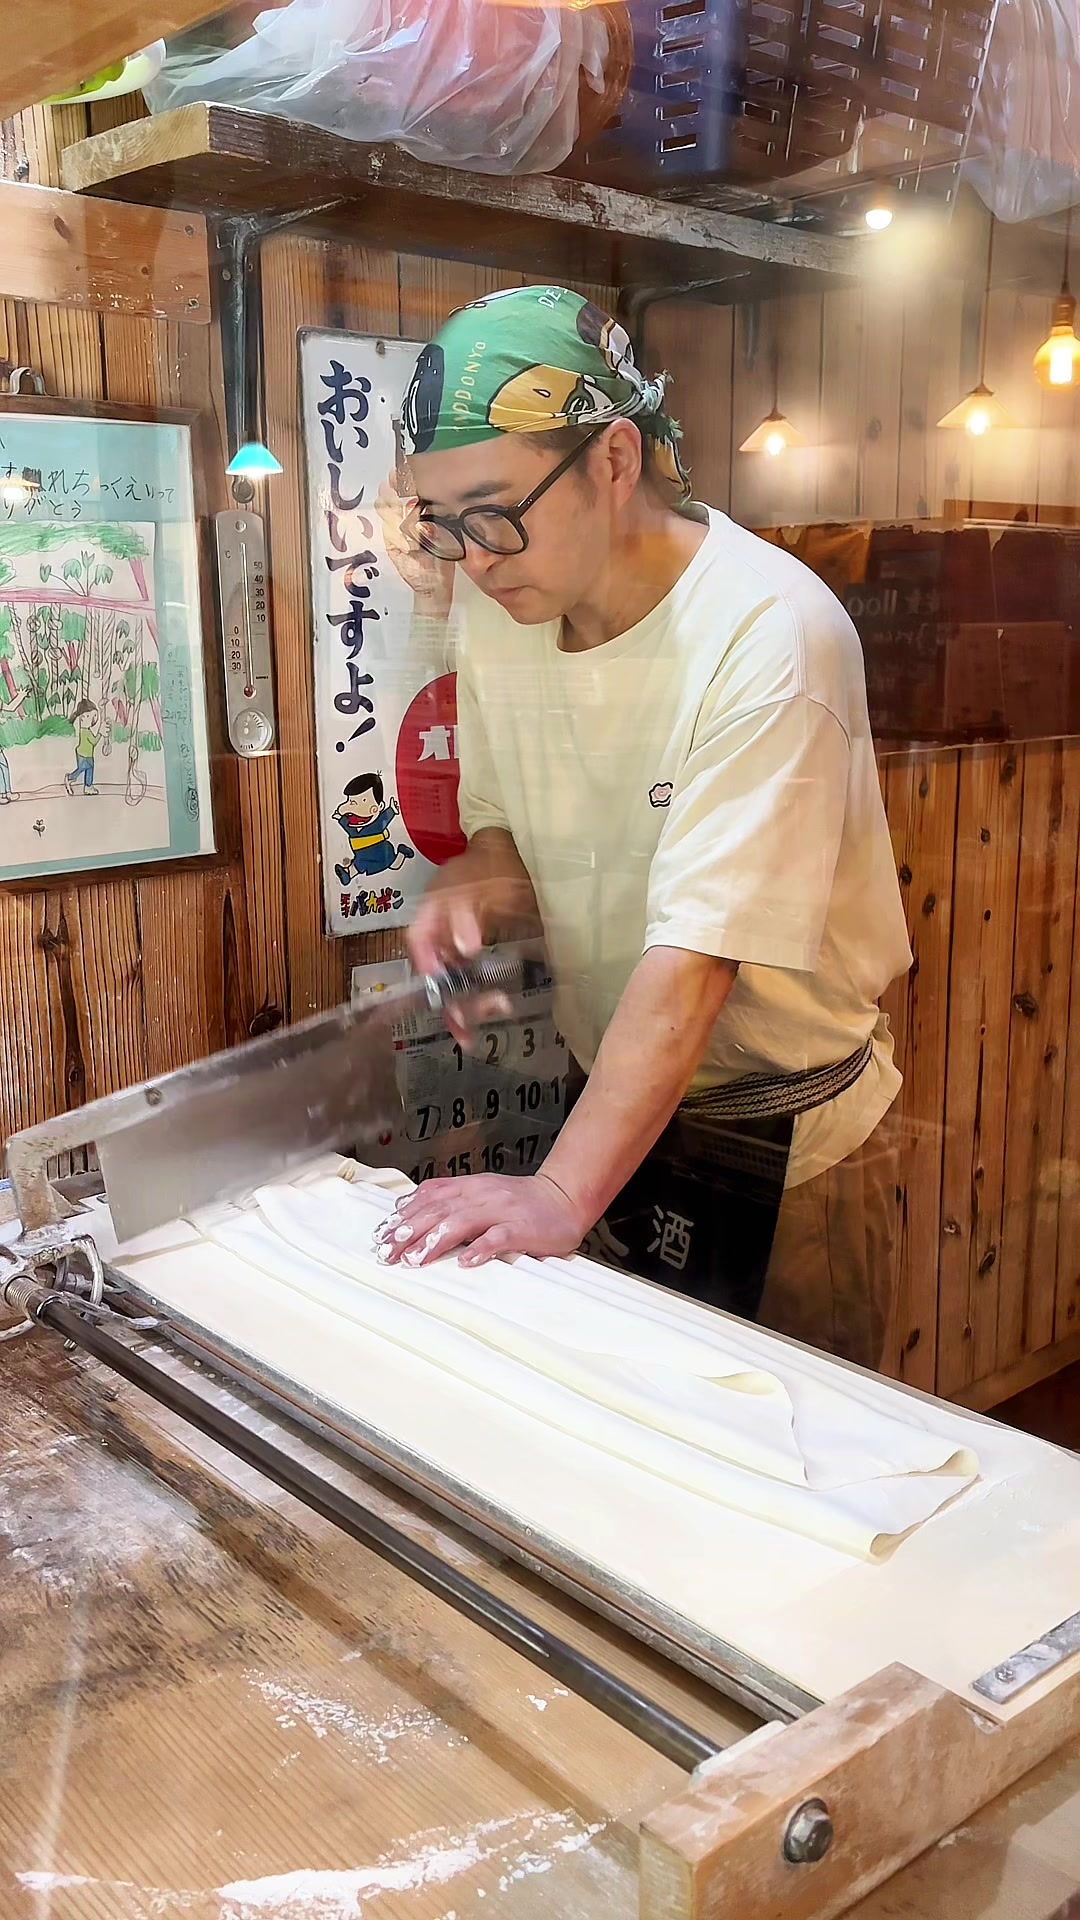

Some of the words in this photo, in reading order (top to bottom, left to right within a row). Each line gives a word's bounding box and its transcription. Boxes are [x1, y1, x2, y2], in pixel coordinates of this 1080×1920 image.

[537, 285, 569, 309] DE
[318, 360, 380, 752] おいしいですよ!
[253, 561, 263, 569] 50
[254, 575, 264, 584] 40
[255, 588, 265, 597] 30
[255, 601, 265, 610] 20
[256, 613, 266, 622] 10
[233, 626, 239, 635] 0
[230, 638, 240, 647] 10
[231, 650, 241, 659] 20
[231, 661, 241, 670] 30
[417, 725, 459, 762] オ
[452, 1043, 463, 1071] 1
[486, 1033, 499, 1065] 2
[523, 1028, 535, 1058] 3
[417, 1106, 431, 1138] 7
[453, 1098, 466, 1129] 8
[486, 1089, 500, 1119] 9
[516, 1081, 541, 1112] 10
[447, 1152, 471, 1177] 15
[481, 1142, 505, 1172] 16
[515, 1134, 540, 1165] 17
[647, 1204, 694, 1270] 酒
